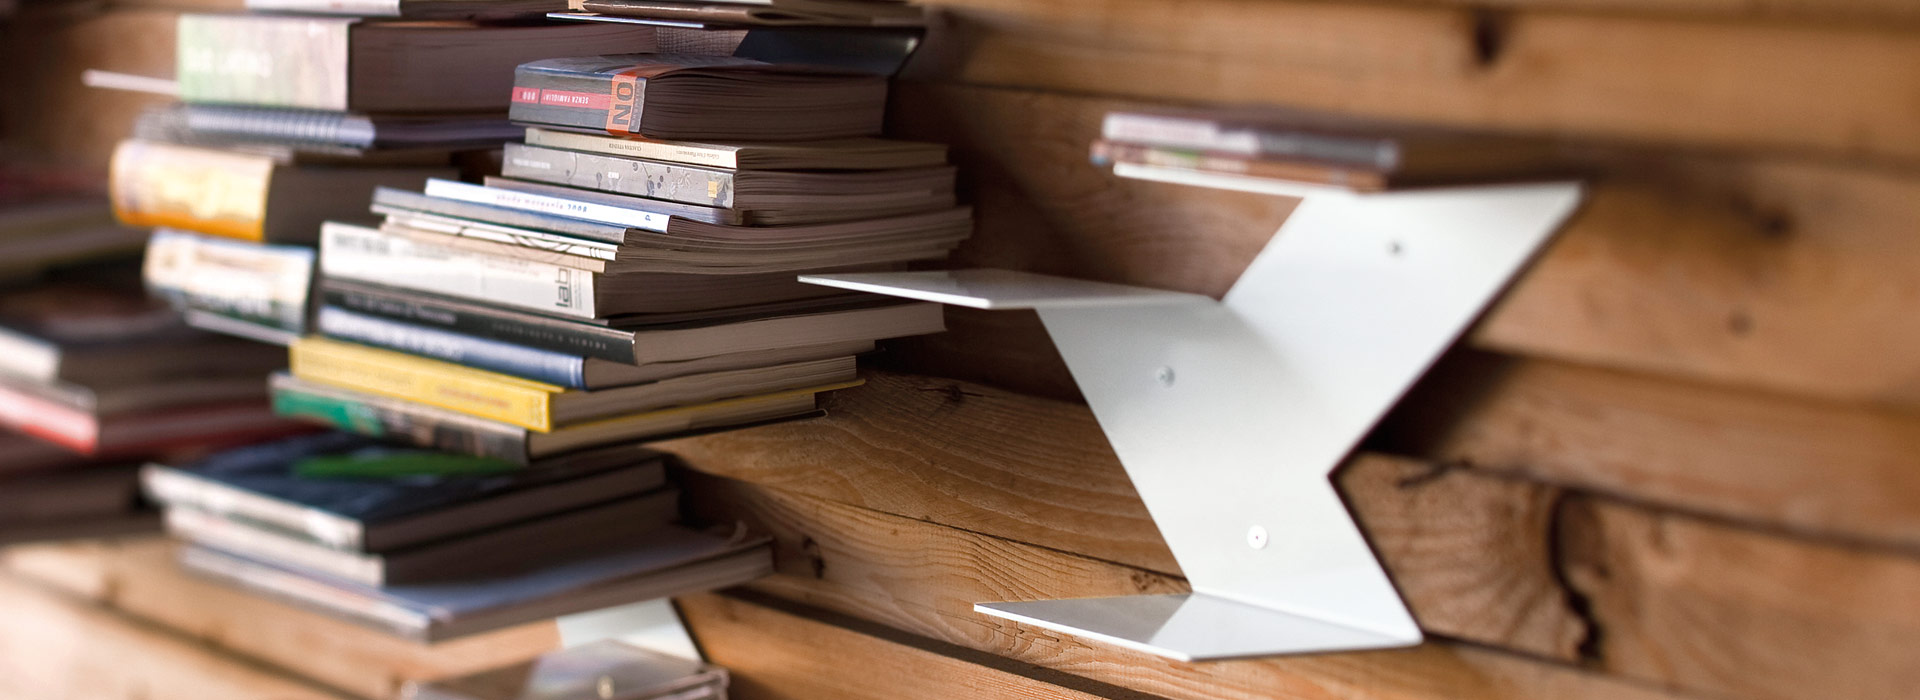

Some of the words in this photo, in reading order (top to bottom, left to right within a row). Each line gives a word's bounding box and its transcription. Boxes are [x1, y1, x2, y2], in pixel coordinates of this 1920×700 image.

[570, 96, 589, 104] SENZA
[612, 82, 634, 125] NO
[555, 268, 570, 307] lab
